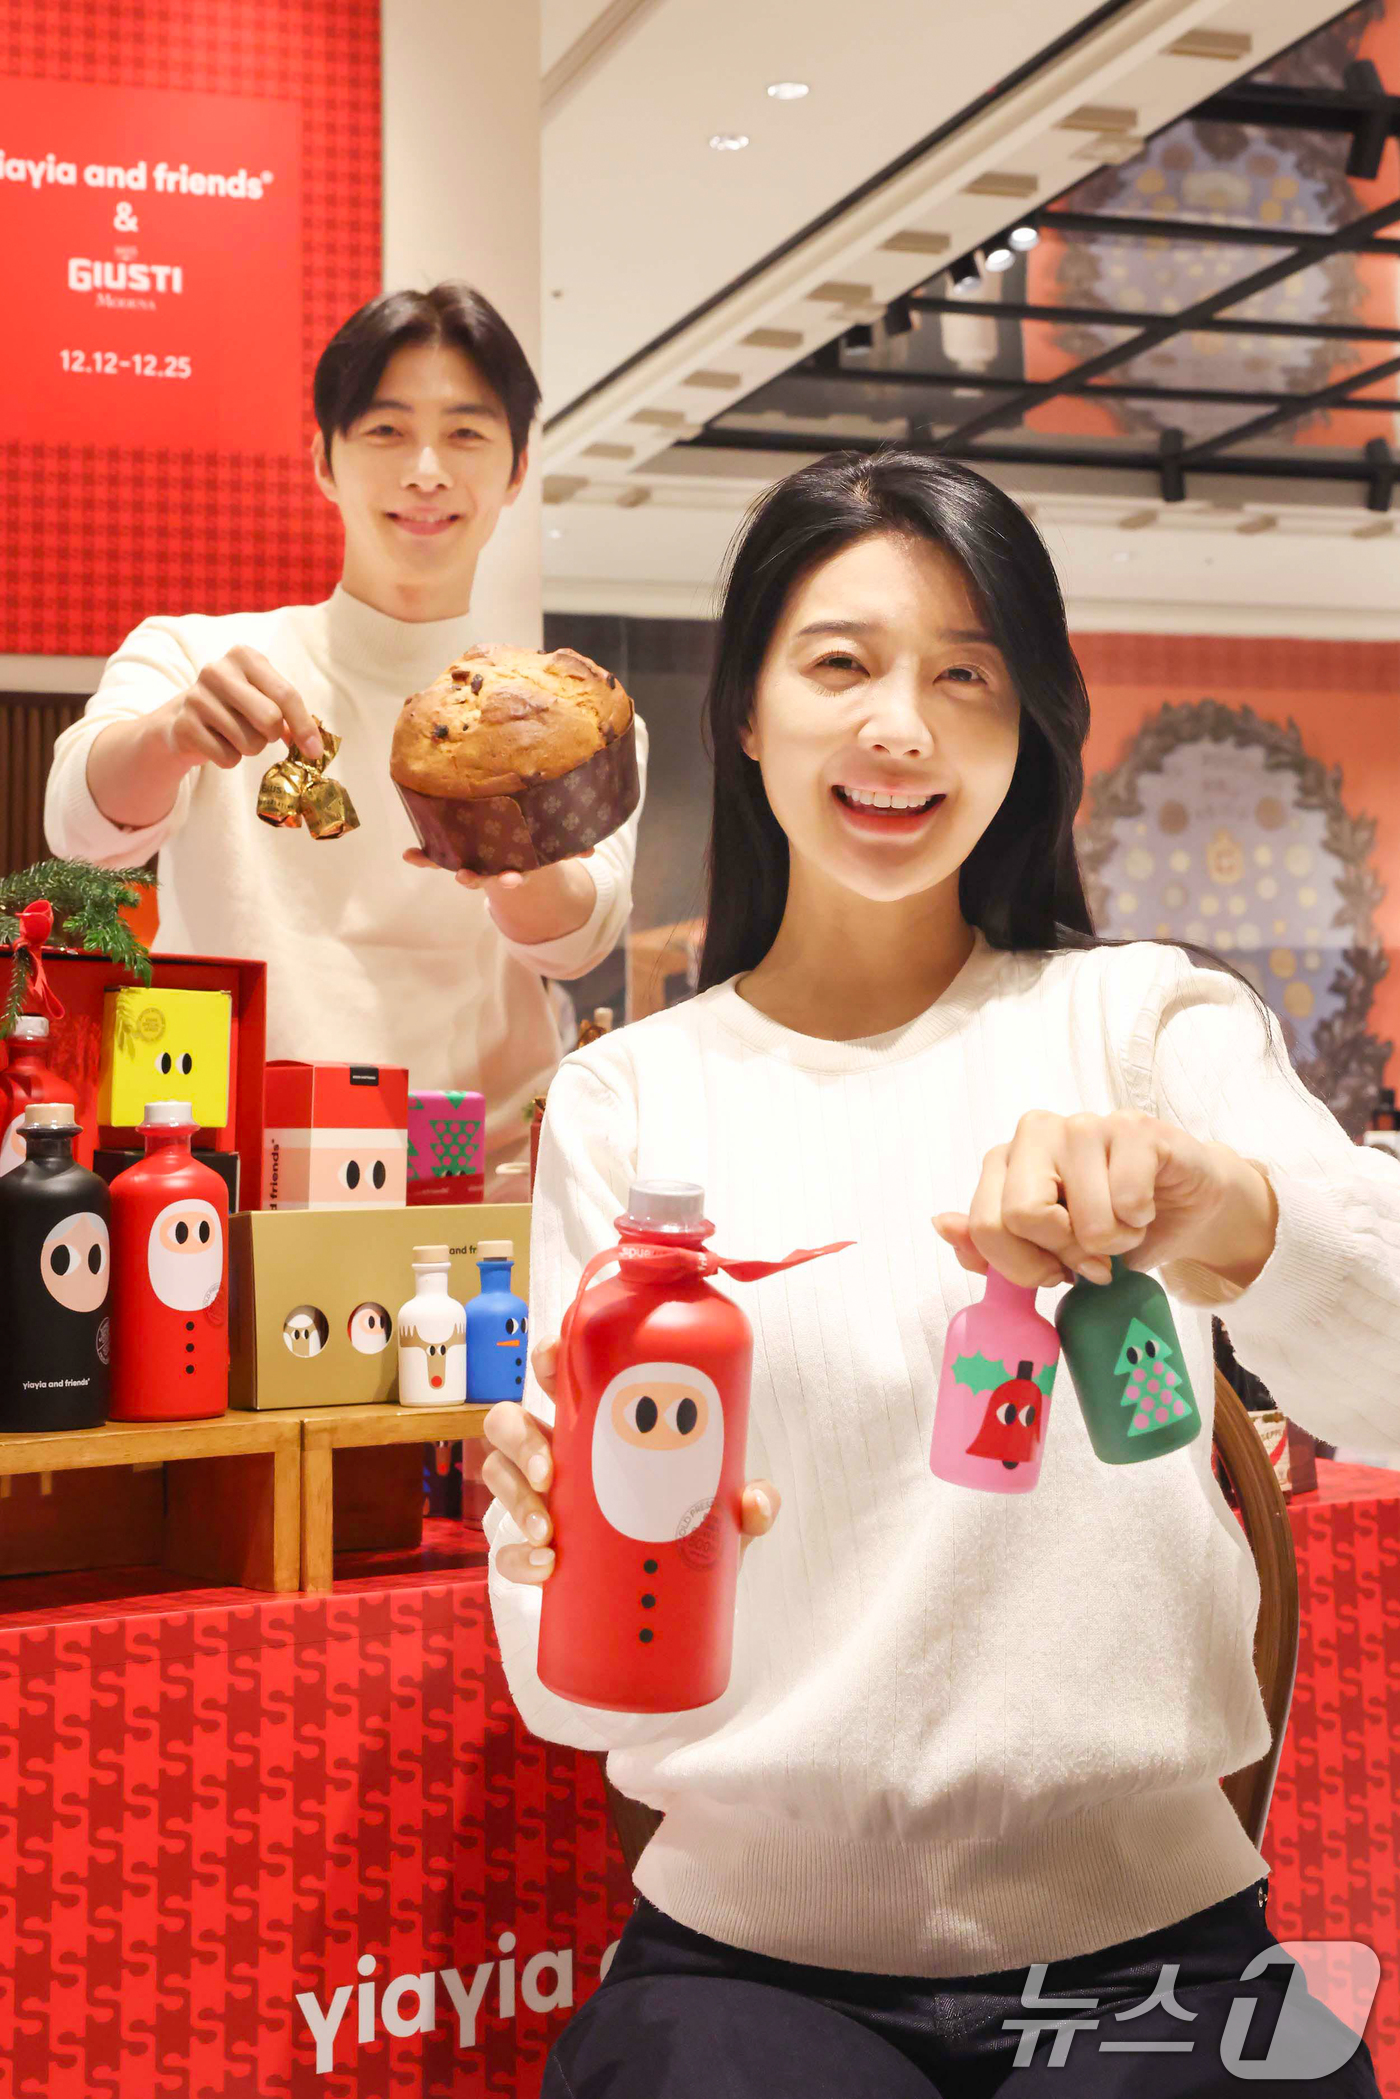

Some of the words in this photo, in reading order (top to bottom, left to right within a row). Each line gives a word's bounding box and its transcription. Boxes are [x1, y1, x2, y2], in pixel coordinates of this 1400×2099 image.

[84, 161, 147, 190] and
[114, 201, 138, 232] &
[68, 257, 183, 294] GIUSTI
[60, 349, 191, 379] 12.12-12.25
[449, 1245, 467, 1255] and
[22, 1380, 47, 1390] yiayia
[48, 1379, 64, 1388] and
[295, 1931, 573, 2075] yiayia
